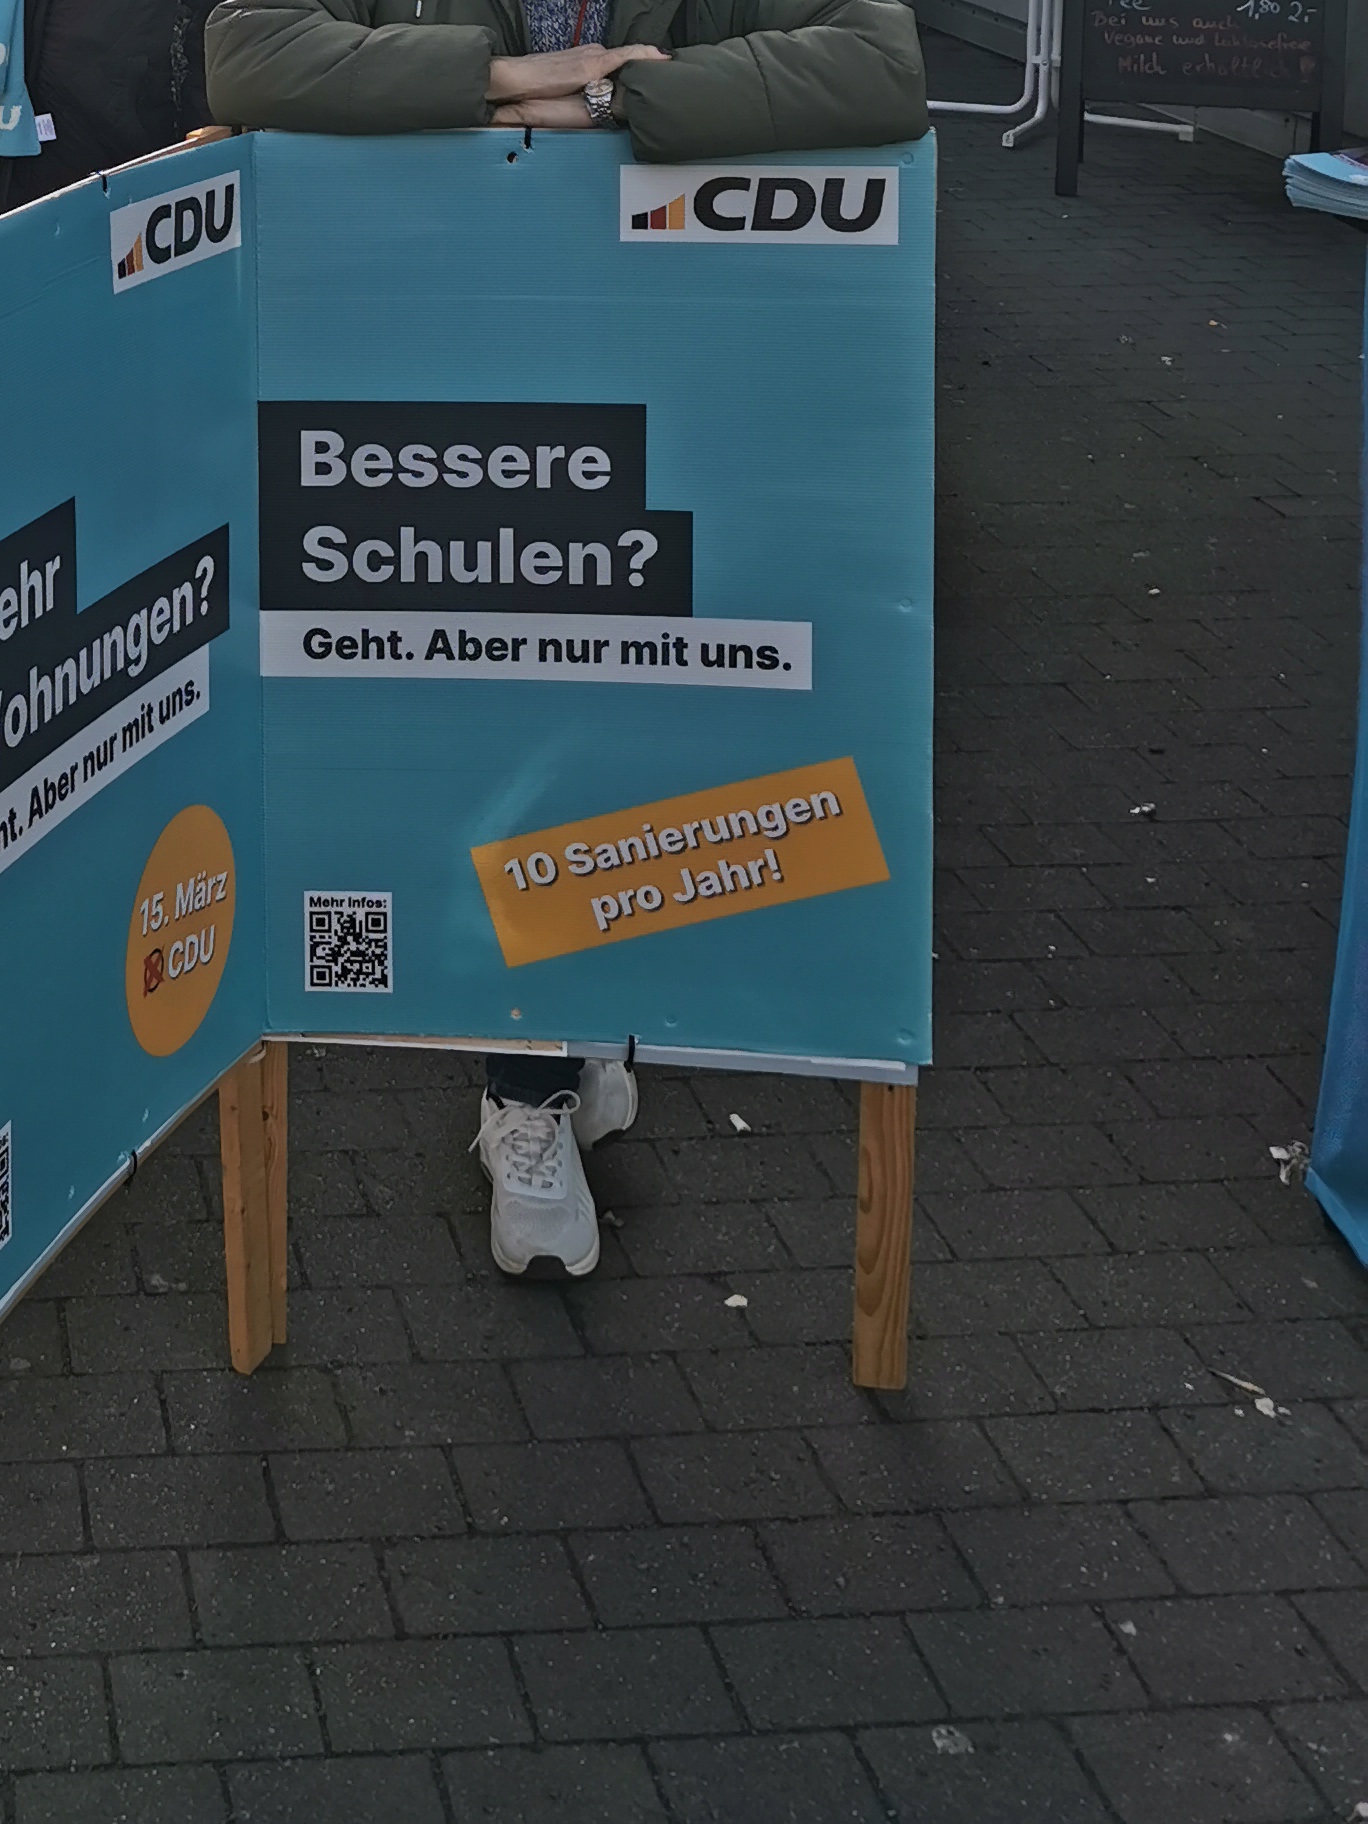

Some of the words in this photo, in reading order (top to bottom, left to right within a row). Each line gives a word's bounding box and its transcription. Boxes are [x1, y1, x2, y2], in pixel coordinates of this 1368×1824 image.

[145, 183, 234, 265] CDU
[693, 176, 887, 233] CDU
[299, 429, 612, 490] Bessere
[301, 525, 659, 588] Schulen?
[303, 628, 415, 663] Geht.
[424, 628, 527, 664] Aber
[538, 637, 609, 665] nur
[620, 633, 689, 668] mit
[700, 640, 793, 673] uns.
[28, 764, 78, 830] Aber
[82, 745, 118, 785] nur
[122, 700, 155, 754] mit
[157, 678, 202, 725] uns.
[504, 850, 559, 892] 10
[564, 788, 843, 876] Sanierungen
[139, 893, 170, 938] 15.
[174, 869, 230, 912] März
[309, 896, 345, 908] Mehr
[347, 896, 387, 909] Infos:
[590, 884, 664, 931] pro
[672, 848, 785, 906] Jahr!
[167, 924, 217, 980] CDU
